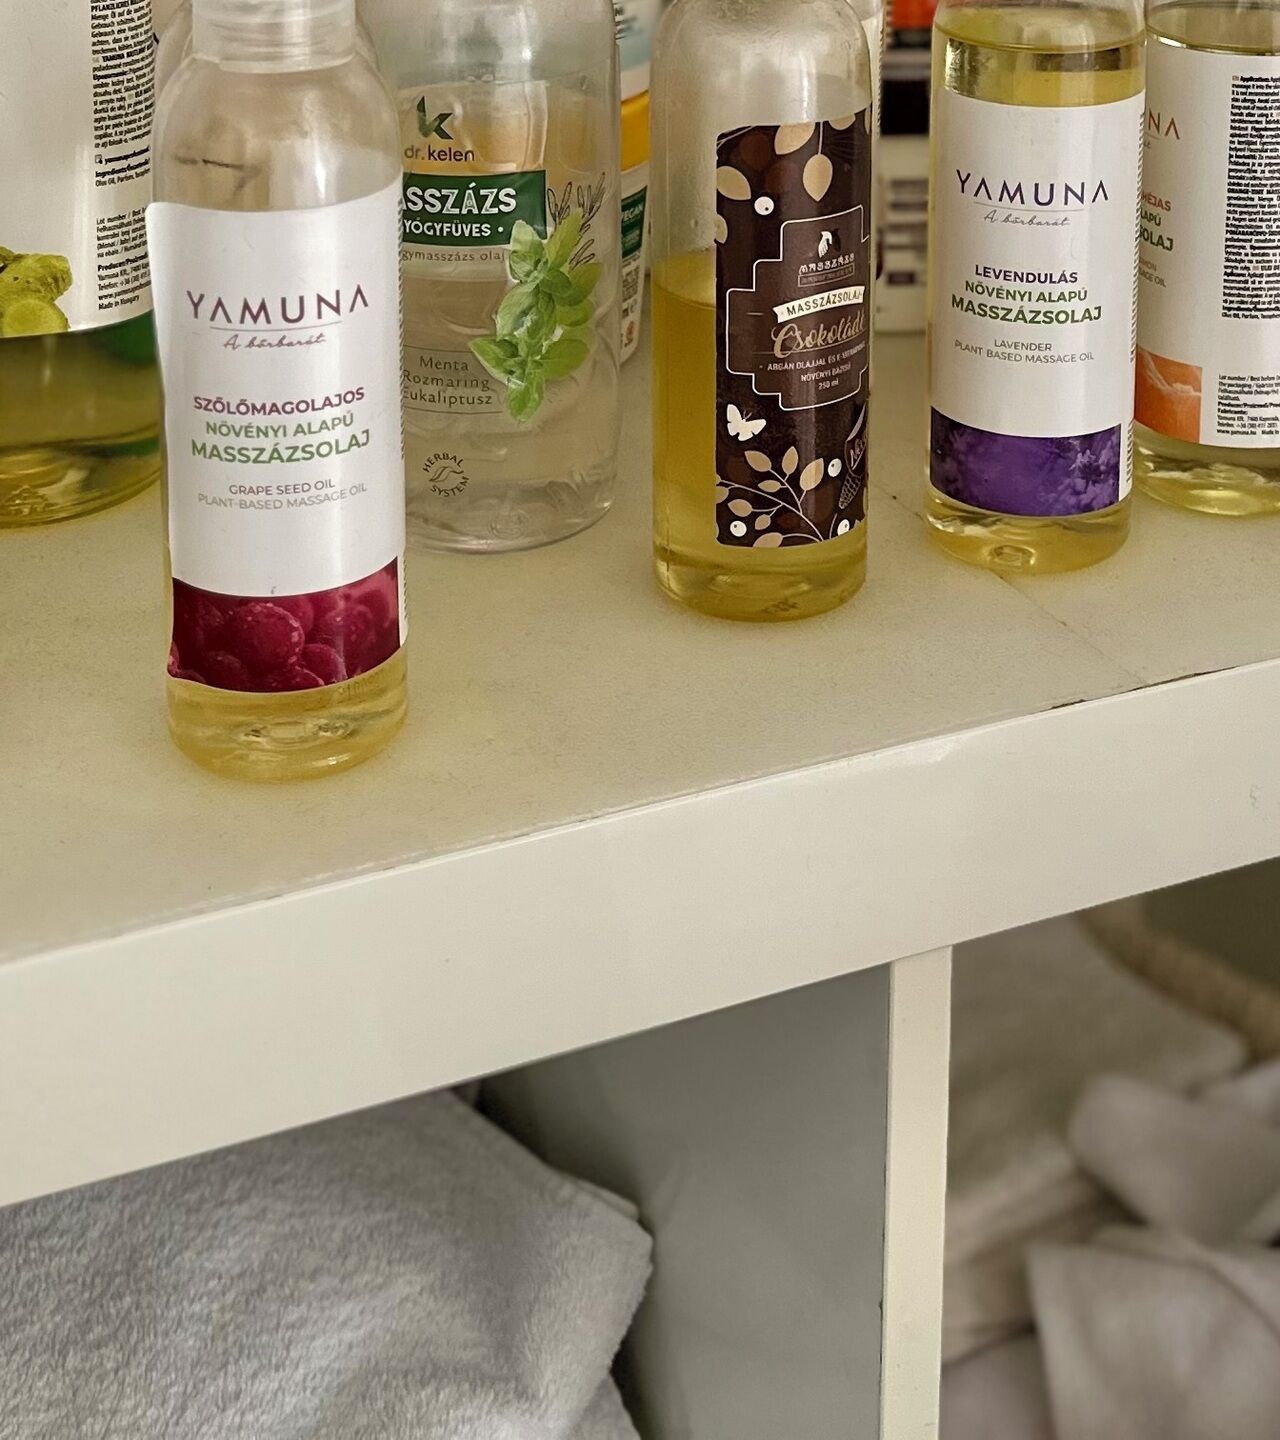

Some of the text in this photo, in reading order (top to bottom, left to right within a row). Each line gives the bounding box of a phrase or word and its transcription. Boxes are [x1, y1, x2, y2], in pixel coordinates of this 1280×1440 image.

[403, 182, 517, 215] SSZÁZS
[956, 169, 1108, 206] YAMUNA
[403, 217, 491, 237] YÓGYFÜVES
[401, 250, 475, 263] gymasszázs
[975, 264, 1078, 284] LEVENDULÁS
[965, 280, 1087, 303] NÖVÉNYI ALAPÚ
[186, 283, 369, 325] YAMUNA
[951, 294, 1102, 324] MASSZÁZSOLAJ
[223, 334, 241, 351] A
[954, 339, 1095, 364] PLANT BASED MASSAGE OIL
[994, 339, 1052, 352] LAVENDER
[420, 355, 469, 371] Menta
[403, 369, 490, 391] Rozmaring
[193, 386, 365, 416] SZŐLŐMAGOLAJOS
[403, 386, 492, 408] Eukaliptusz
[205, 411, 354, 439] NÖVÉNYI ALAPÚ
[191, 428, 371, 464] MASSZÁZSOLAJ
[422, 452, 463, 473] HERBAL
[198, 482, 367, 510] PLANT-BASED MASSAGE OIL
[228, 478, 336, 496] GRAPE SEED OIL
[429, 475, 469, 498] SYSTEM
